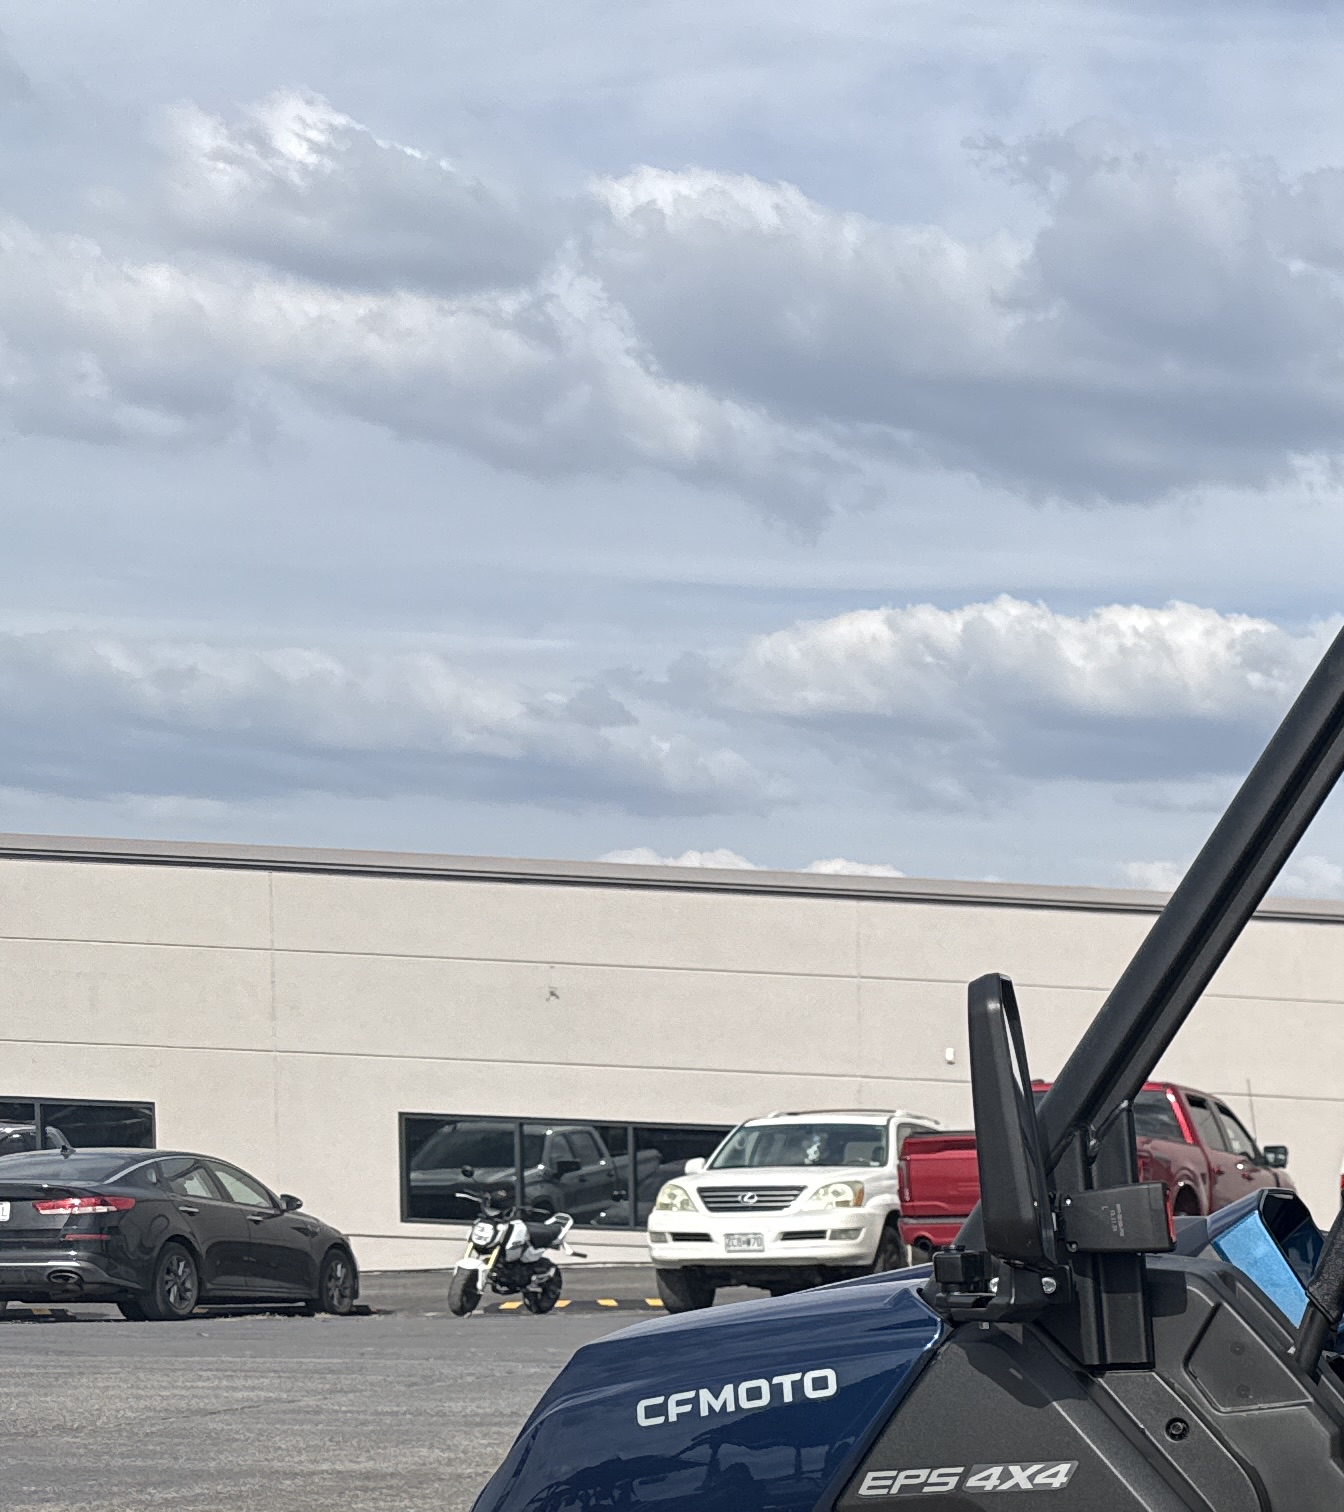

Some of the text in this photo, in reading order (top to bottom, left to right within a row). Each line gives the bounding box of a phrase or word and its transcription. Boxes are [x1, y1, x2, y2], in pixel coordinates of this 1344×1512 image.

[636, 1368, 838, 1427] CFMOTO
[858, 1463, 1072, 1496] EPS 4X4
